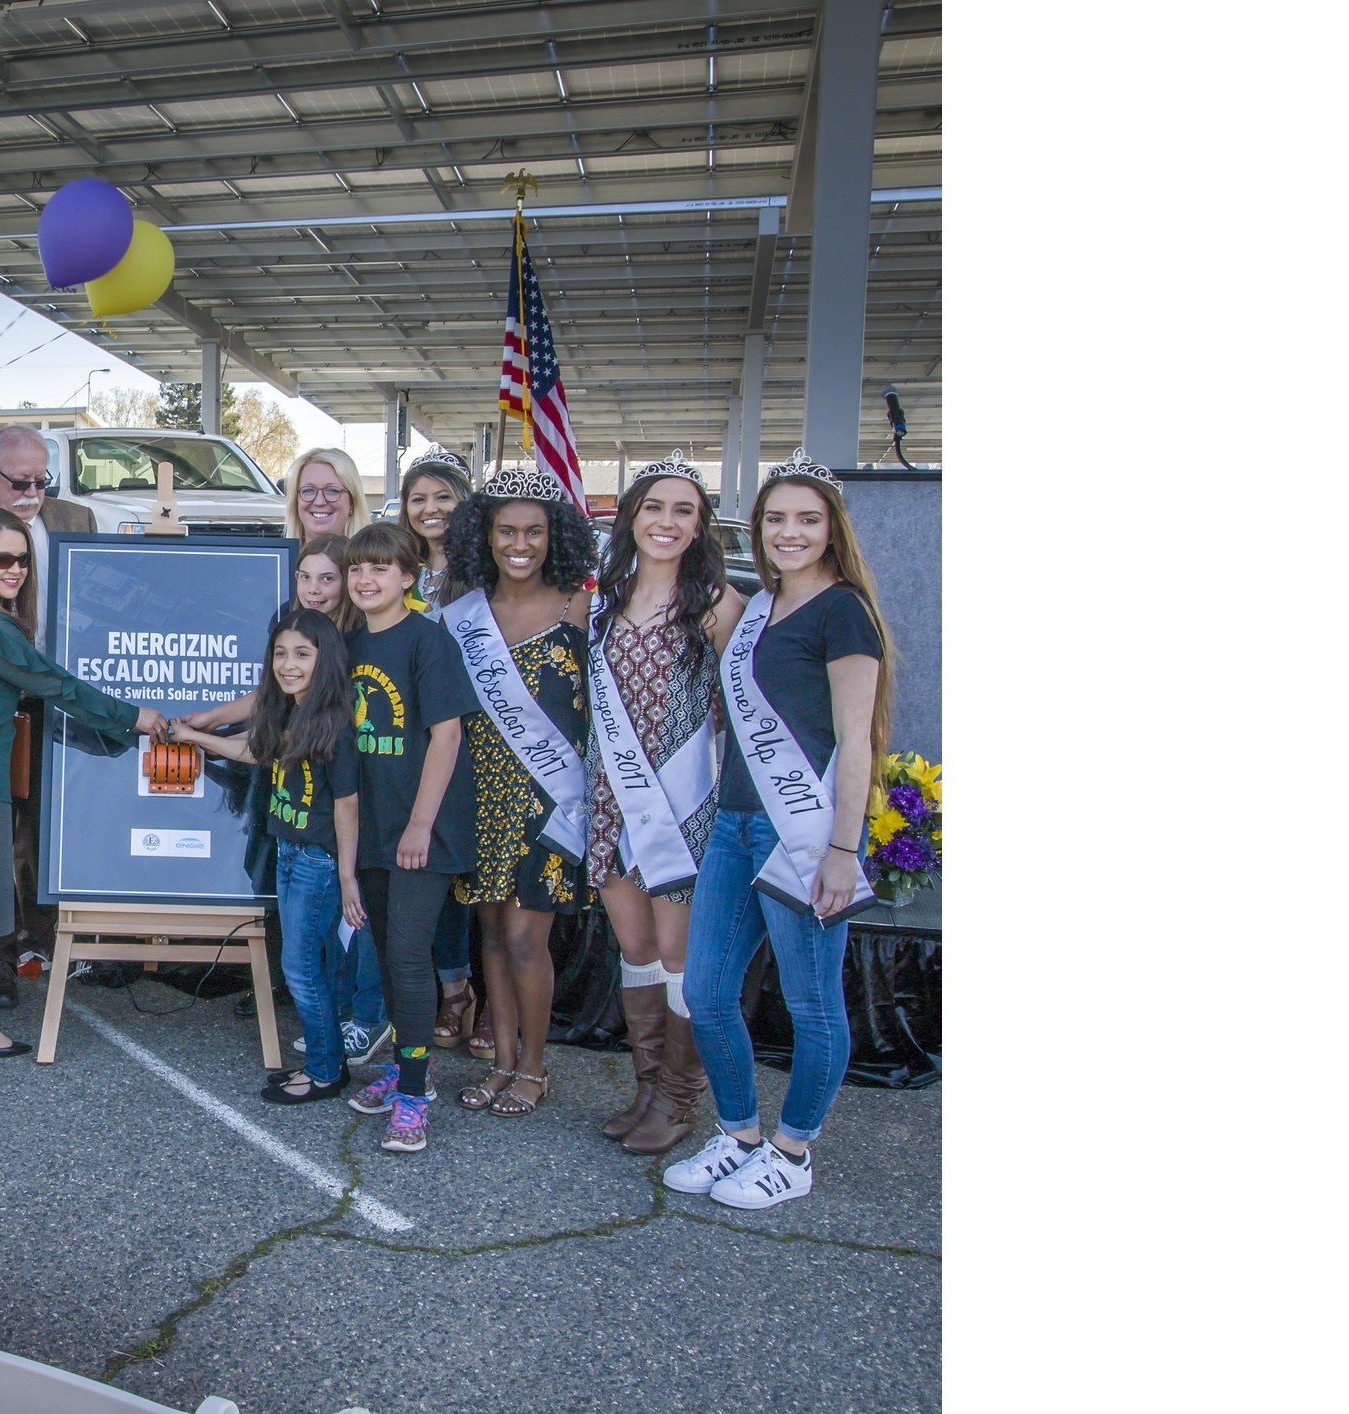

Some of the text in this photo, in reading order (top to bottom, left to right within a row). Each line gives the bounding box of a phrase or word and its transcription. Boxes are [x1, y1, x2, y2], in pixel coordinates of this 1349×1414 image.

[77, 658, 263, 686] ESCALON UNIFIED
[108, 631, 238, 658] ENERGIZING
[102, 685, 121, 698] the
[125, 686, 164, 700] Switch
[167, 687, 199, 701] Solar
[202, 689, 236, 702] Event
[351, 664, 405, 729] LEMENTARY
[456, 620, 568, 777] Miss Escalon 2017
[592, 650, 651, 789] Photogenic 2017
[730, 614, 825, 815] 1st Runner Up 2017
